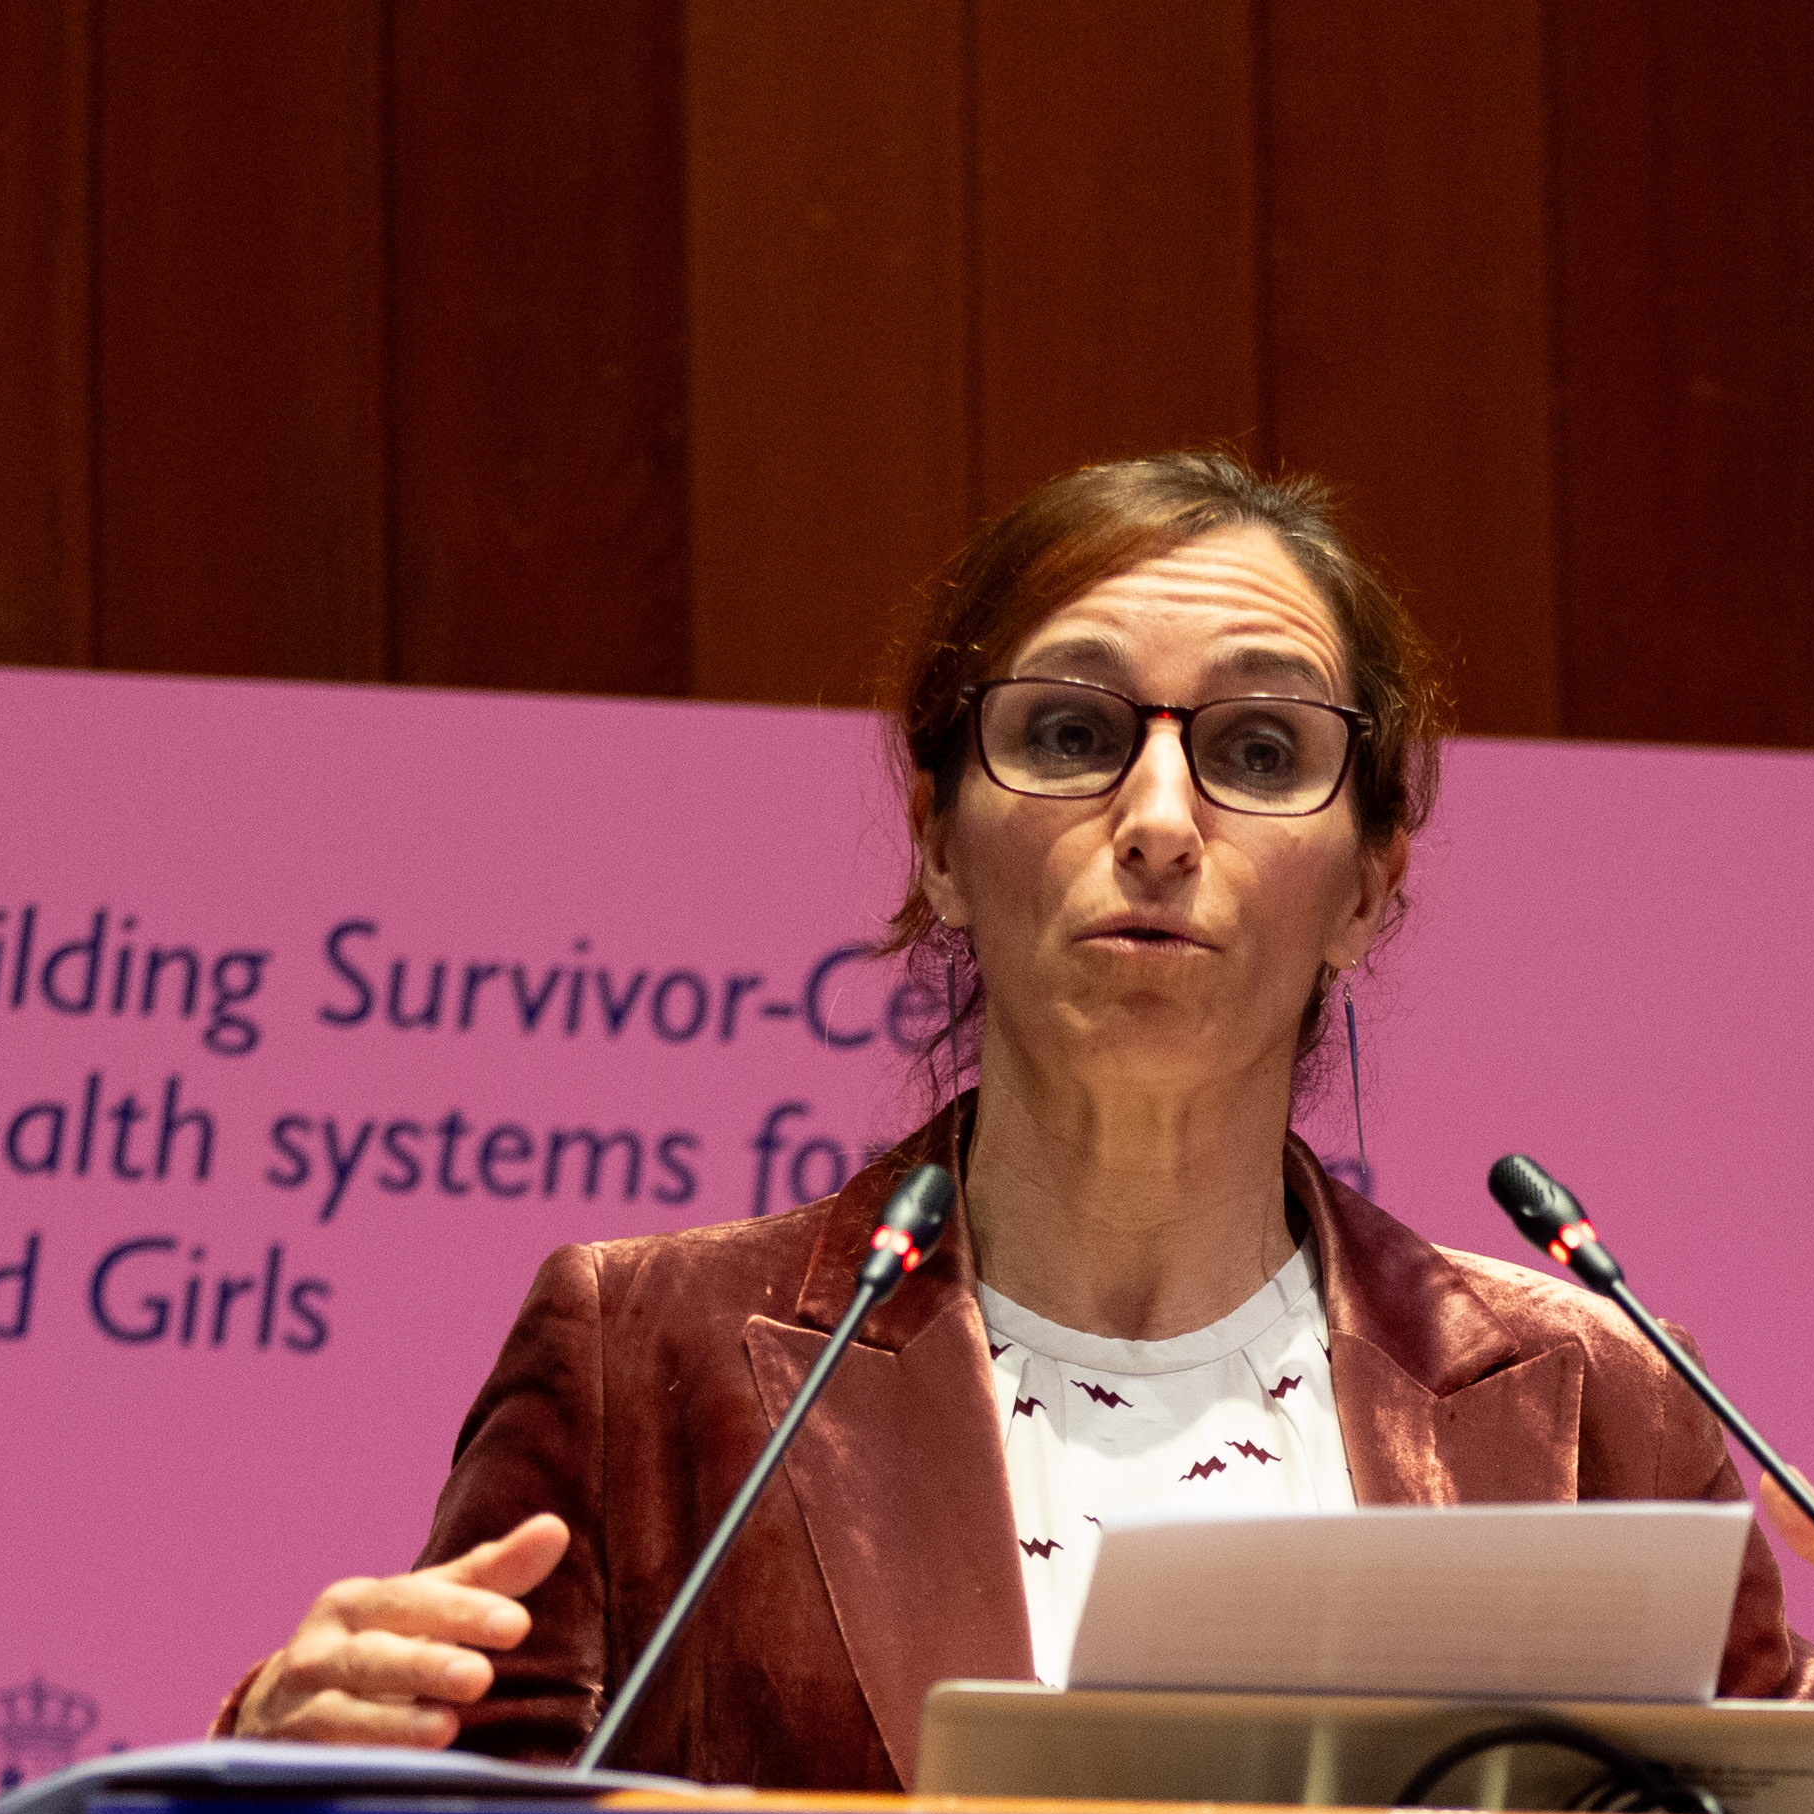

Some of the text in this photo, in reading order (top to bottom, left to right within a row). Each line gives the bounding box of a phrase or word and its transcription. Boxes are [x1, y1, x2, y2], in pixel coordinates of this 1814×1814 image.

[264, 1107, 700, 1226] systems
[750, 1099, 895, 1217] fo
[85, 1233, 332, 1356] Girls
